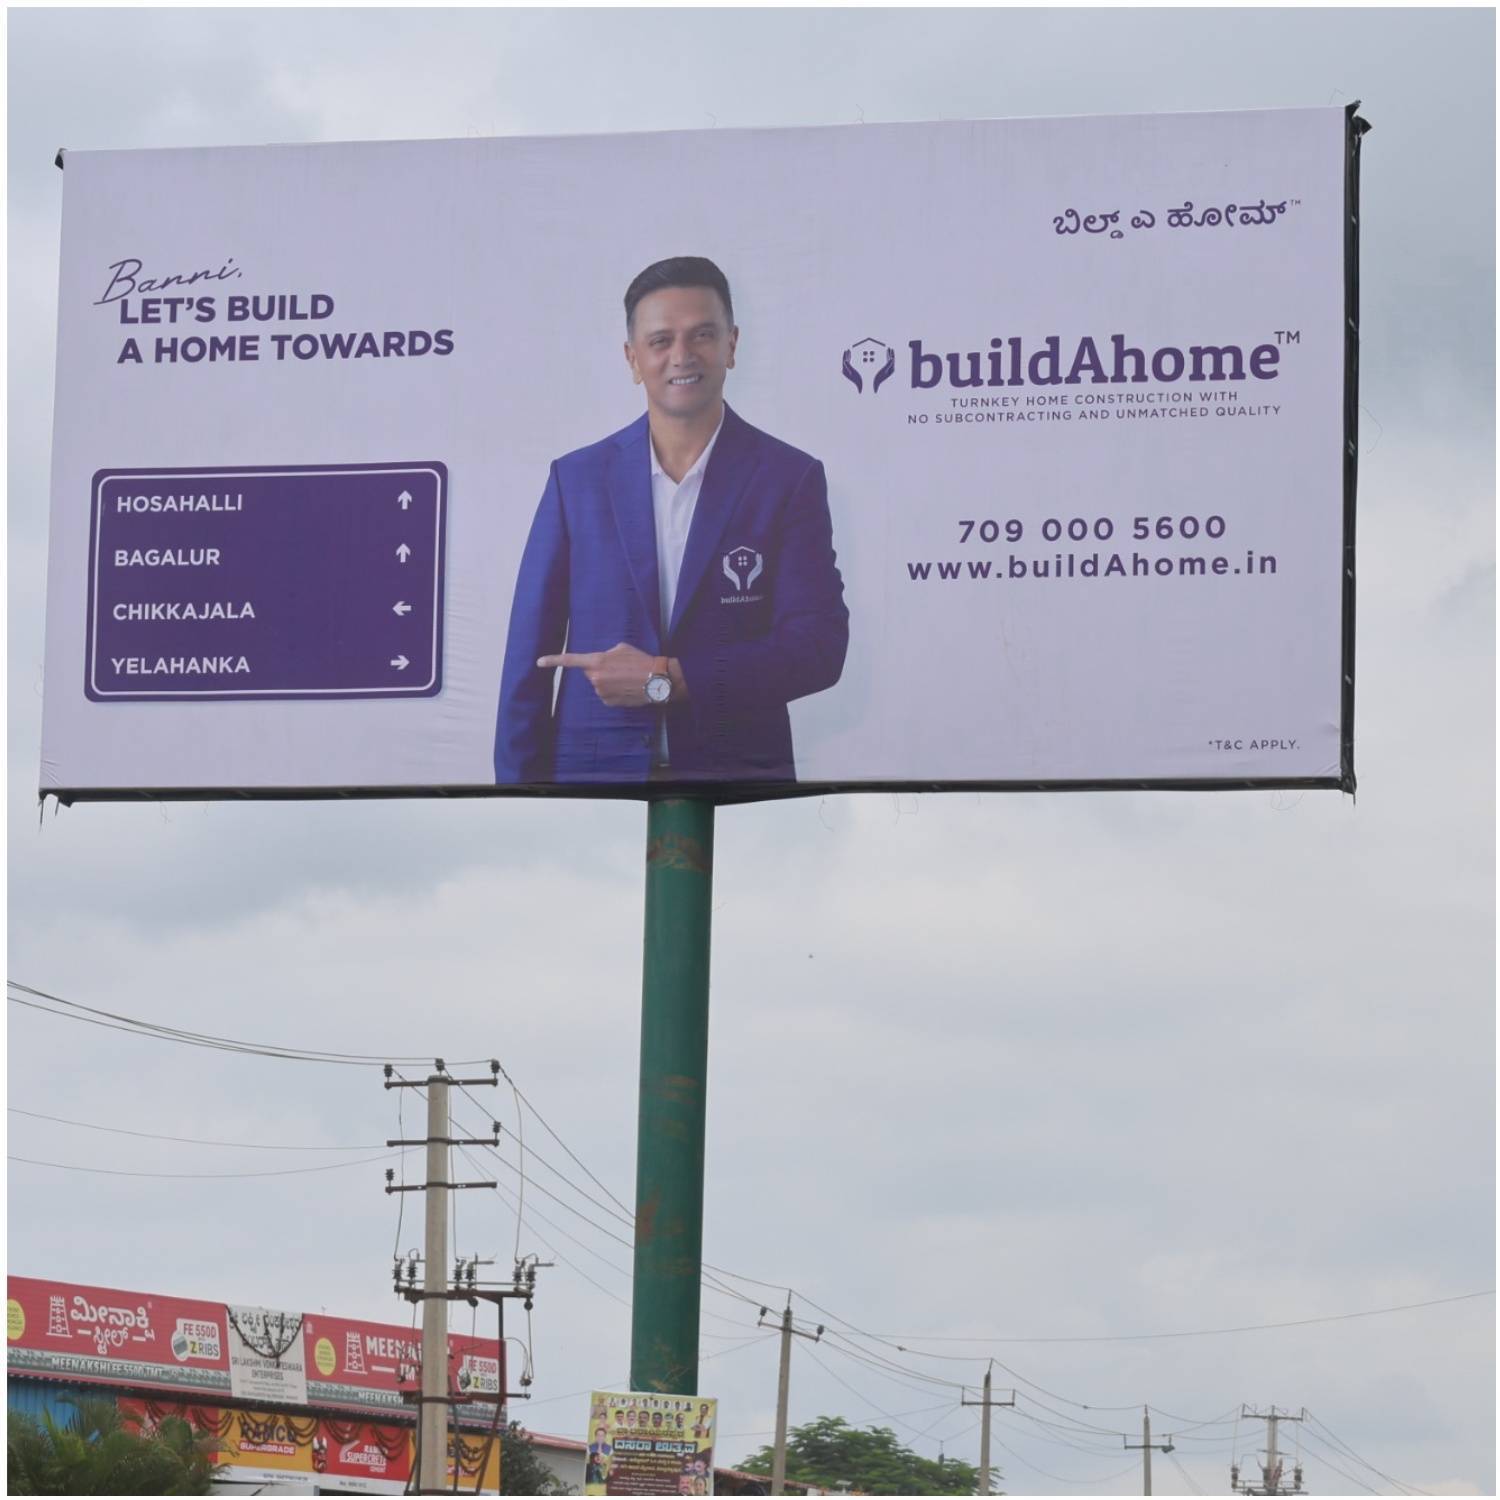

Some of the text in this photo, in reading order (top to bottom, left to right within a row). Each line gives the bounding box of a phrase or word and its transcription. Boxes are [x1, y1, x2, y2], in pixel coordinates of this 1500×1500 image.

[1131, 210, 1155, 229] ಎ
[119, 294, 334, 325] LET’S BUILD
[117, 329, 454, 364] A HOME TOWARDS
[951, 391, 1238, 409] TURNKEY HOME CONSTRUCTION WITH
[907, 405, 1282, 425] NO SUBCONTRACTING AND UNMATCHED QUALITY
[117, 494, 242, 513] HOSAHALLI
[958, 514, 1226, 543] 709 000 5600
[114, 548, 220, 567] BAGALUR
[907, 551, 1277, 581] www.buildAhome.in
[112, 601, 255, 621] CHIKKAJALA
[111, 655, 250, 675] YELAHANKA
[1249, 738, 1300, 751] APPLY.
[183, 1322, 194, 1336] FE
[189, 1340, 219, 1357] Z RIBS
[480, 1378, 498, 1391] RIBS
